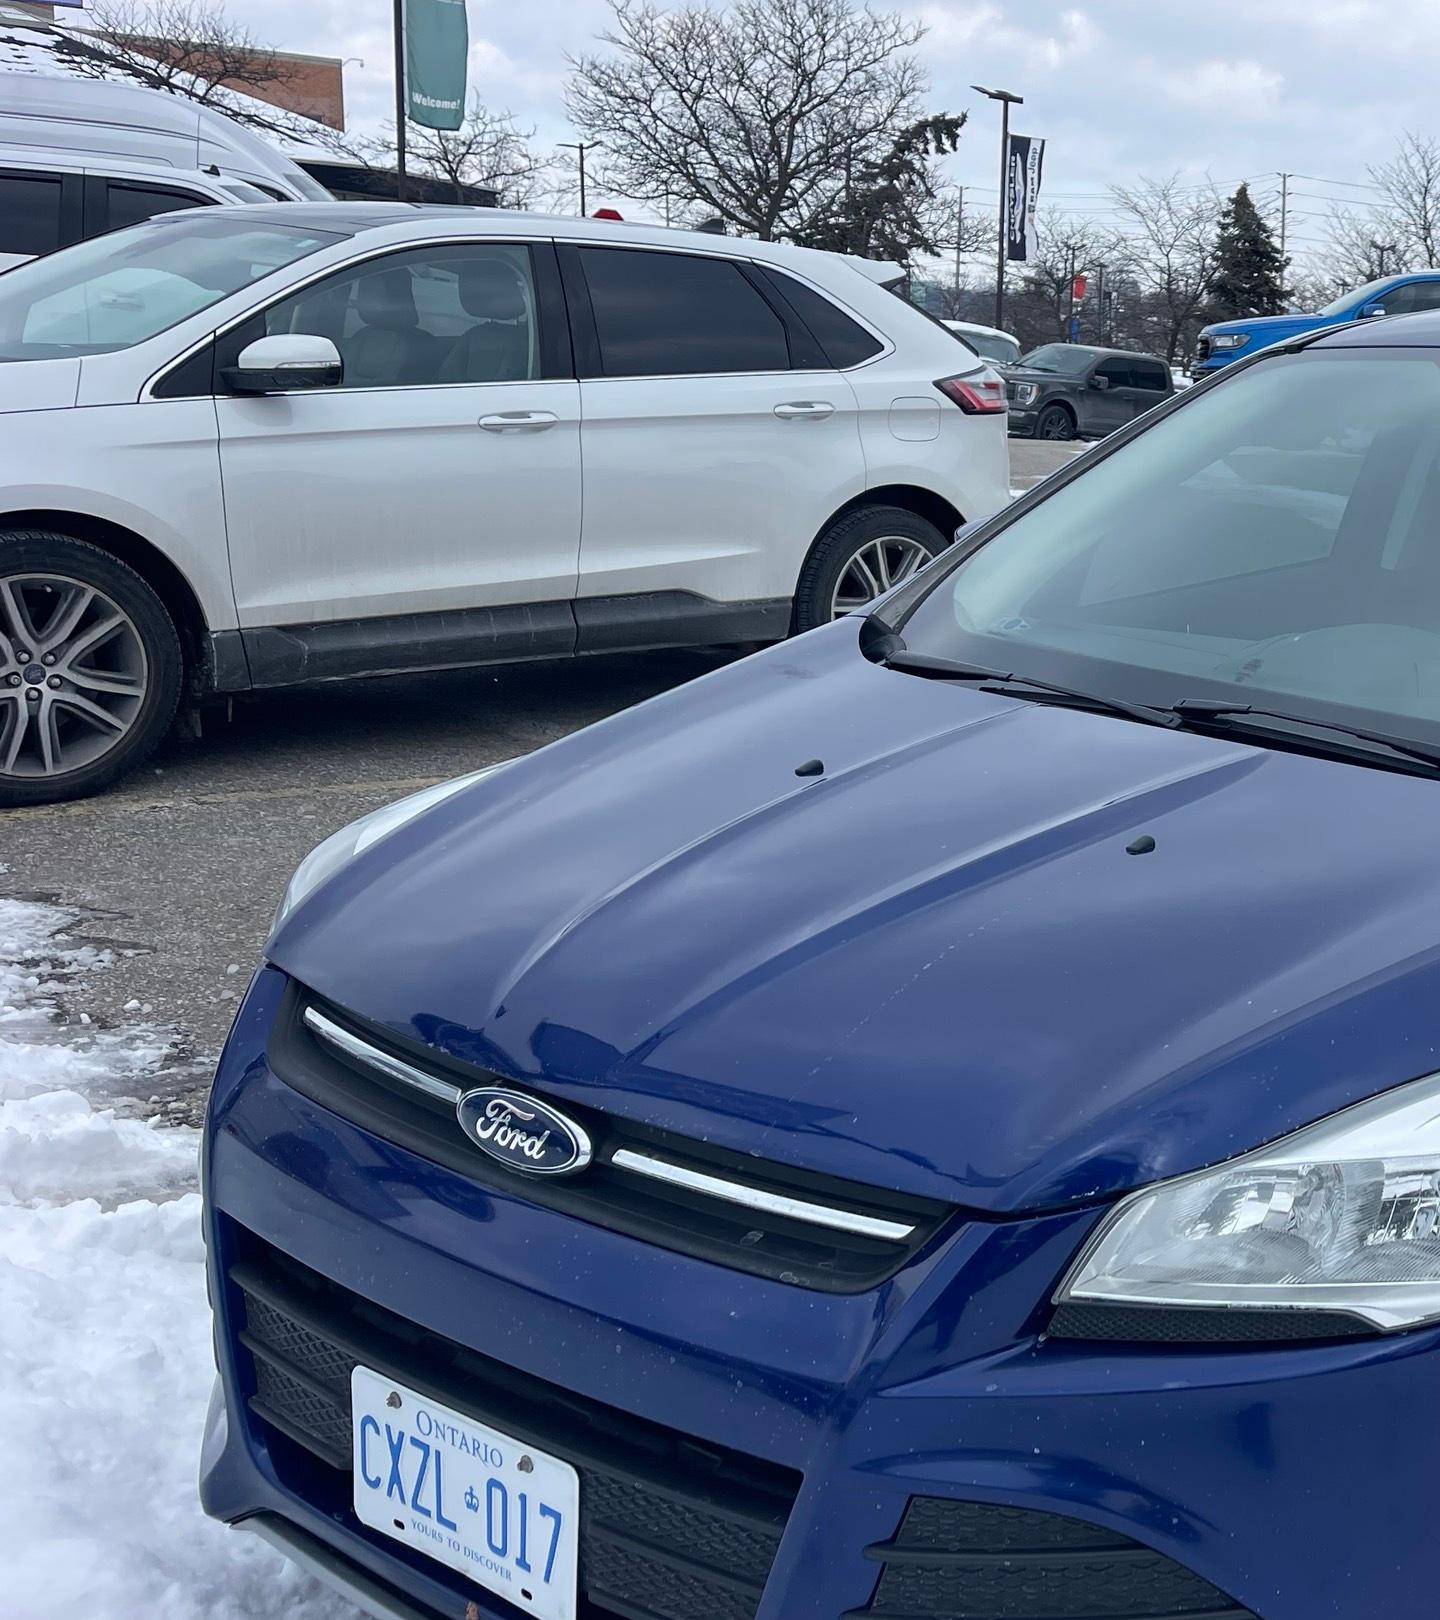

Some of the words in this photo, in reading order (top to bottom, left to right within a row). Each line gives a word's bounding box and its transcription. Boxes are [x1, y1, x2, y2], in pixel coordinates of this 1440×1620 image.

[412, 91, 460, 109] Welcome!
[1028, 147, 1038, 174] Jeep
[475, 1099, 550, 1159] Ford
[416, 1410, 503, 1469] ONTARIO
[360, 1414, 457, 1532] CXZL
[486, 1477, 562, 1584] 017
[411, 1519, 443, 1543] YOURS
[447, 1538, 461, 1553] TO
[464, 1547, 512, 1582] DISCOVER
